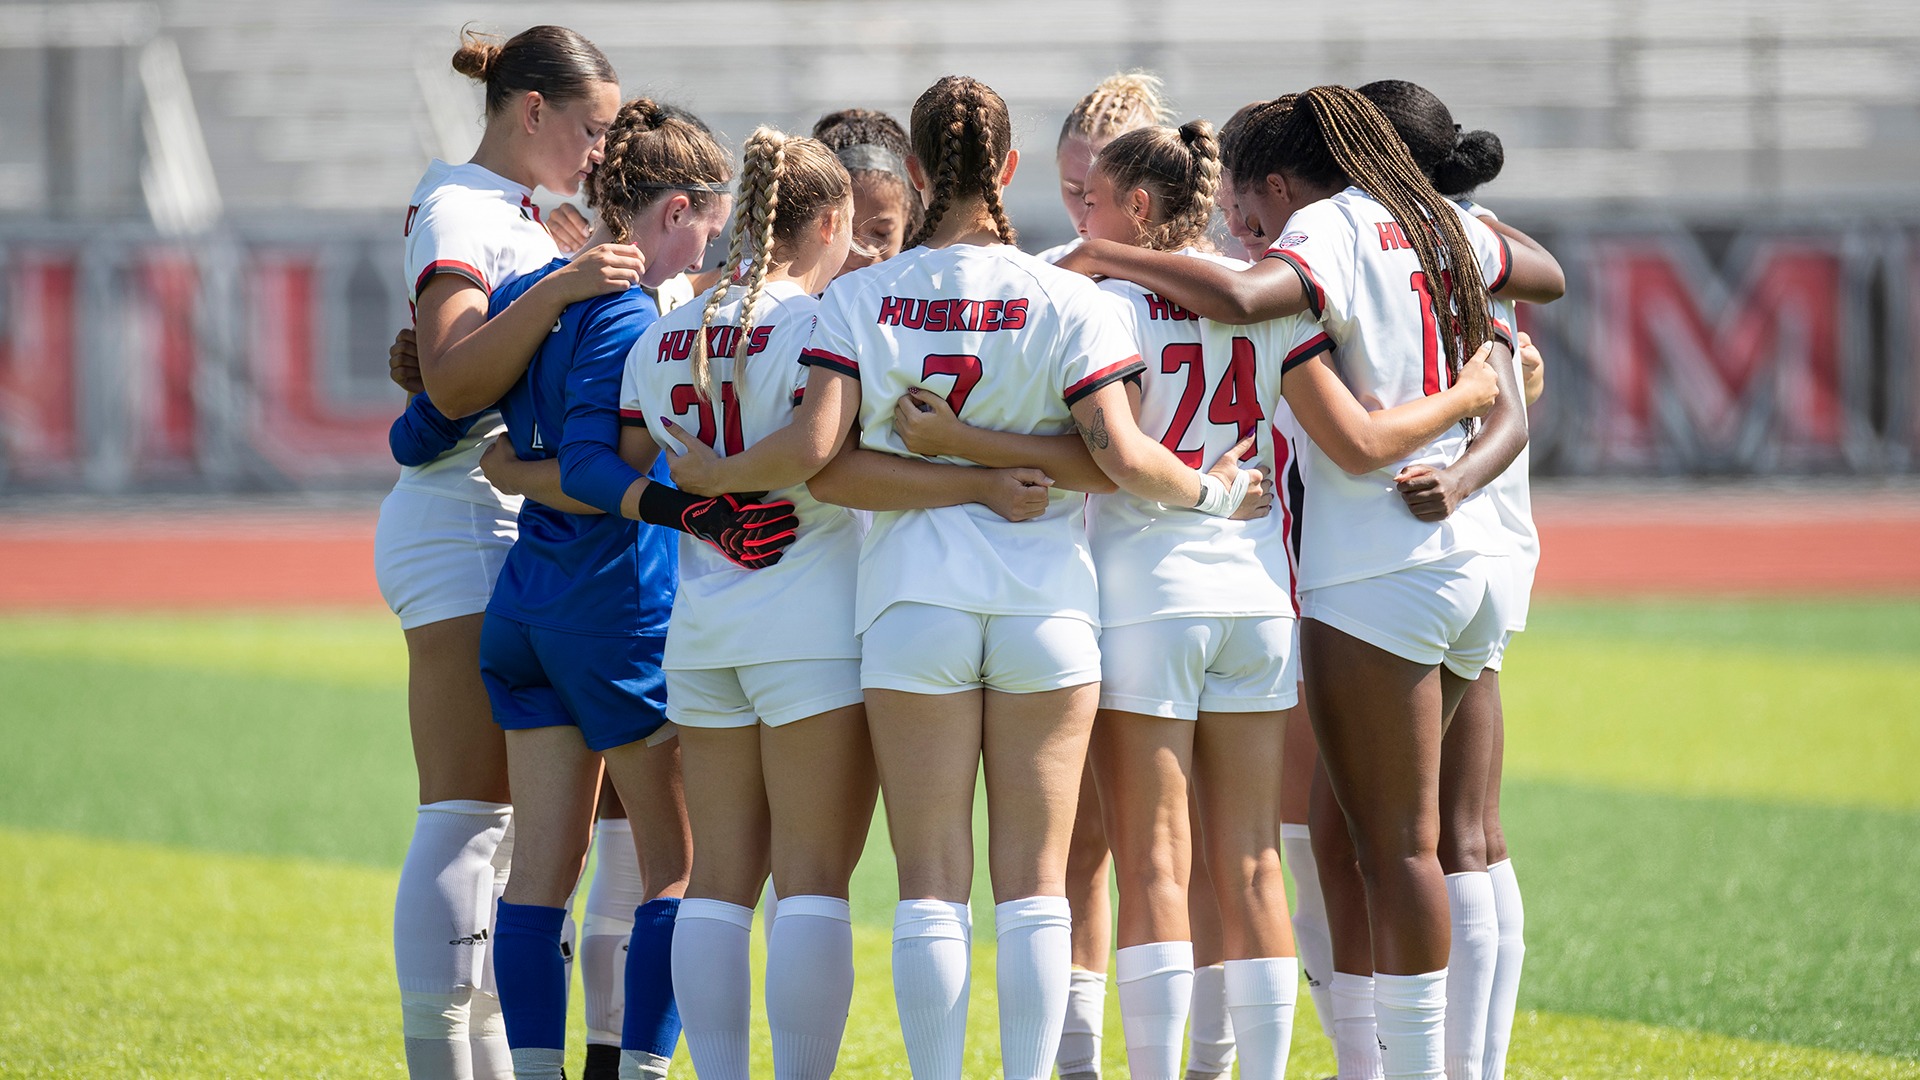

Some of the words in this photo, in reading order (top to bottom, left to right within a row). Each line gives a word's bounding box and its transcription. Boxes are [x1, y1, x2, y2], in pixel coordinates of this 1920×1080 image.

[877, 296, 1029, 332] HUSKIES
[921, 353, 983, 418] 7
[1160, 336, 1265, 470] 24
